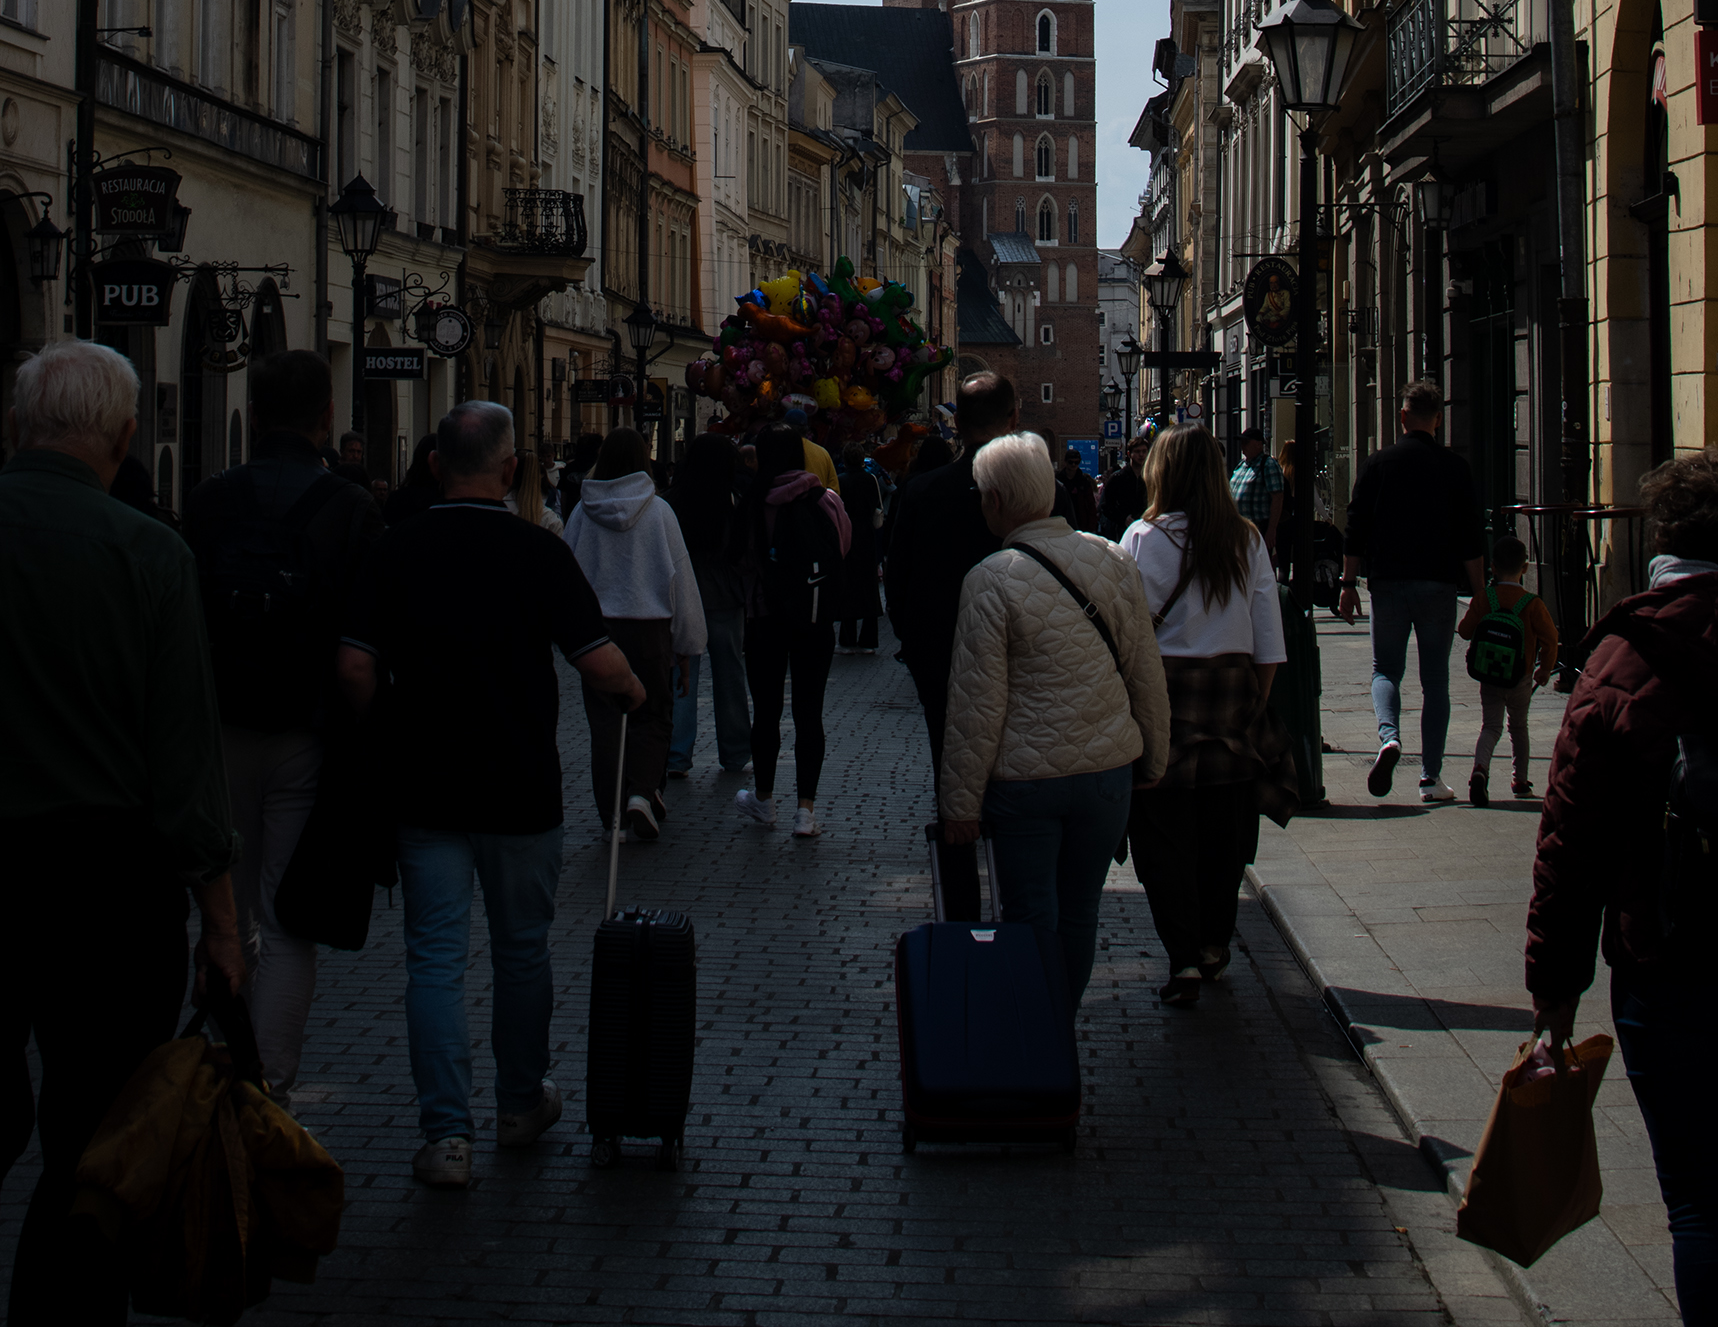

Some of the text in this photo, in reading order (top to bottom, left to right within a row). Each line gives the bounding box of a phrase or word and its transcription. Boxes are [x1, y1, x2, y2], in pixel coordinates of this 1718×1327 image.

[101, 178, 166, 195] RESTAURACJA
[111, 207, 156, 225] STODOŁA
[1247, 261, 1299, 299] PUB RESTAURACJA
[103, 284, 160, 307] PUB
[365, 356, 421, 370] HOSTEL
[1108, 423, 1119, 437] P
[501, 1119, 518, 1128] FILA
[446, 1154, 464, 1162] FILA
